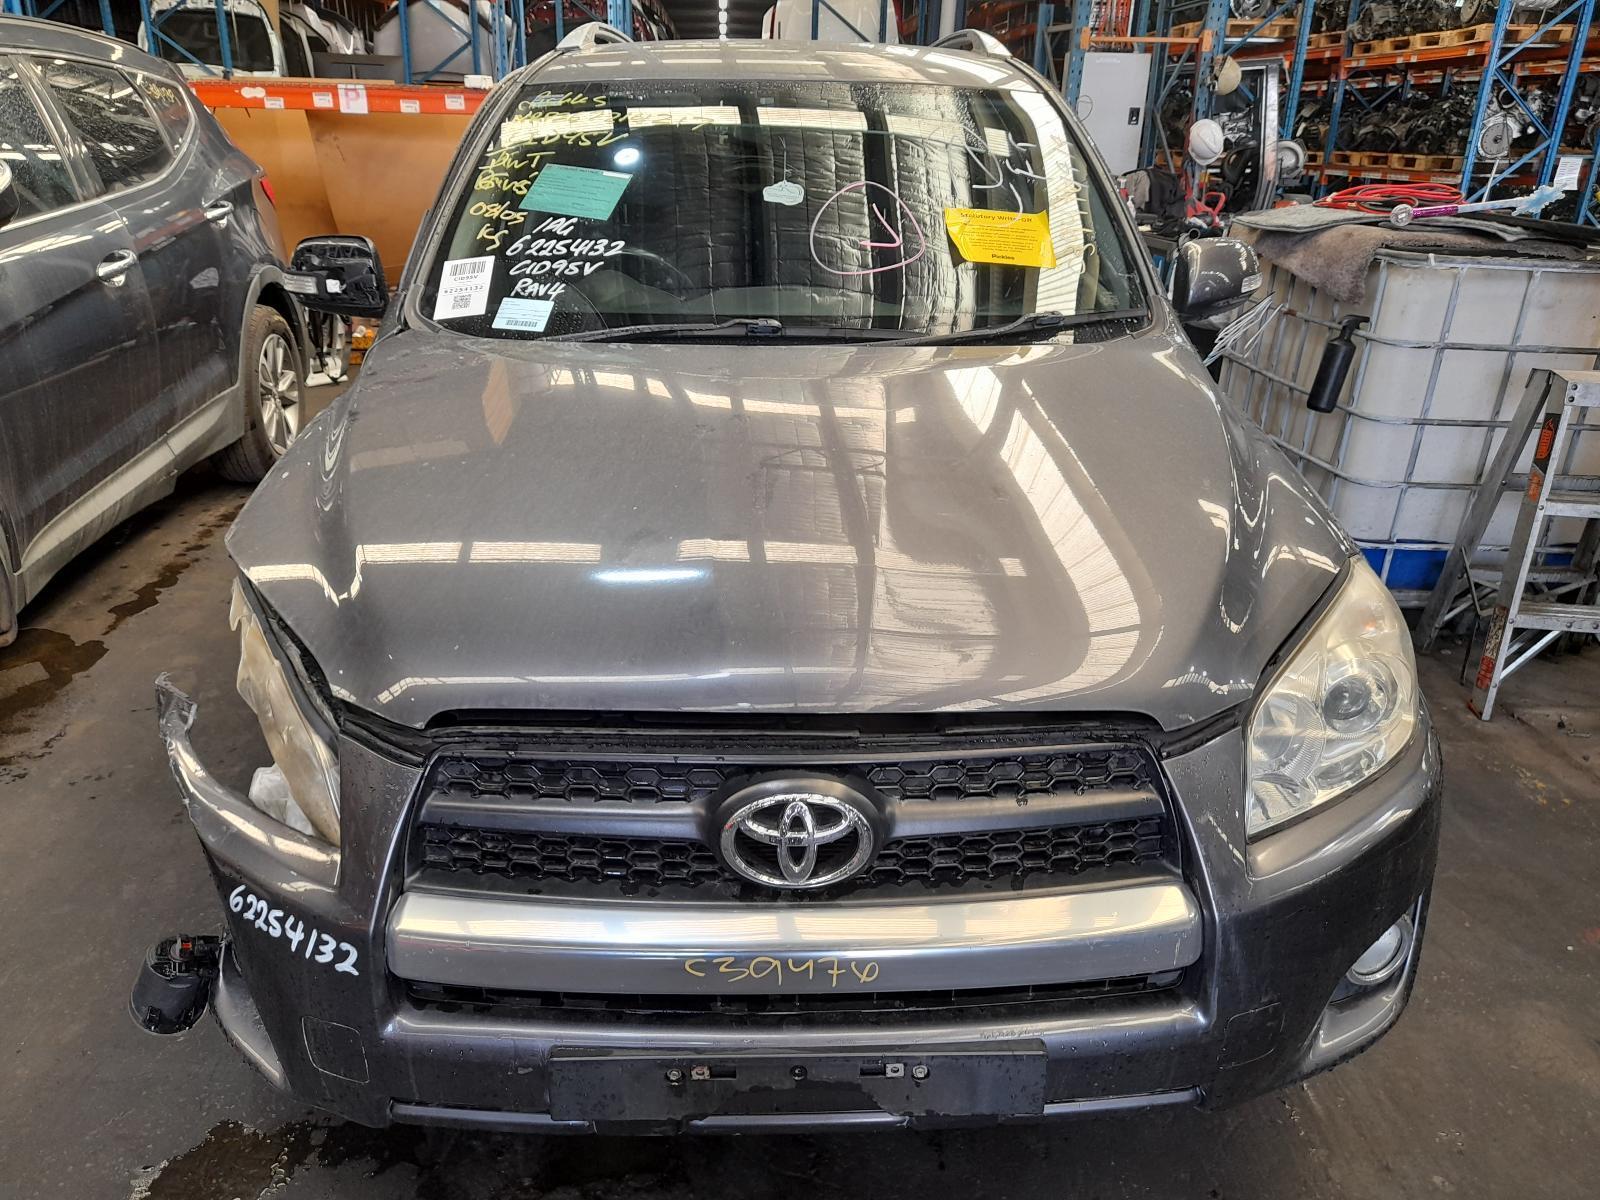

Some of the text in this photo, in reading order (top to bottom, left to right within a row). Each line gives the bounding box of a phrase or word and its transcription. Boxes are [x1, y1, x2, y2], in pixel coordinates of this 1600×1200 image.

[505, 234, 626, 257] 62254132
[509, 277, 567, 302] RAV4
[229, 884, 360, 976] 62254132
